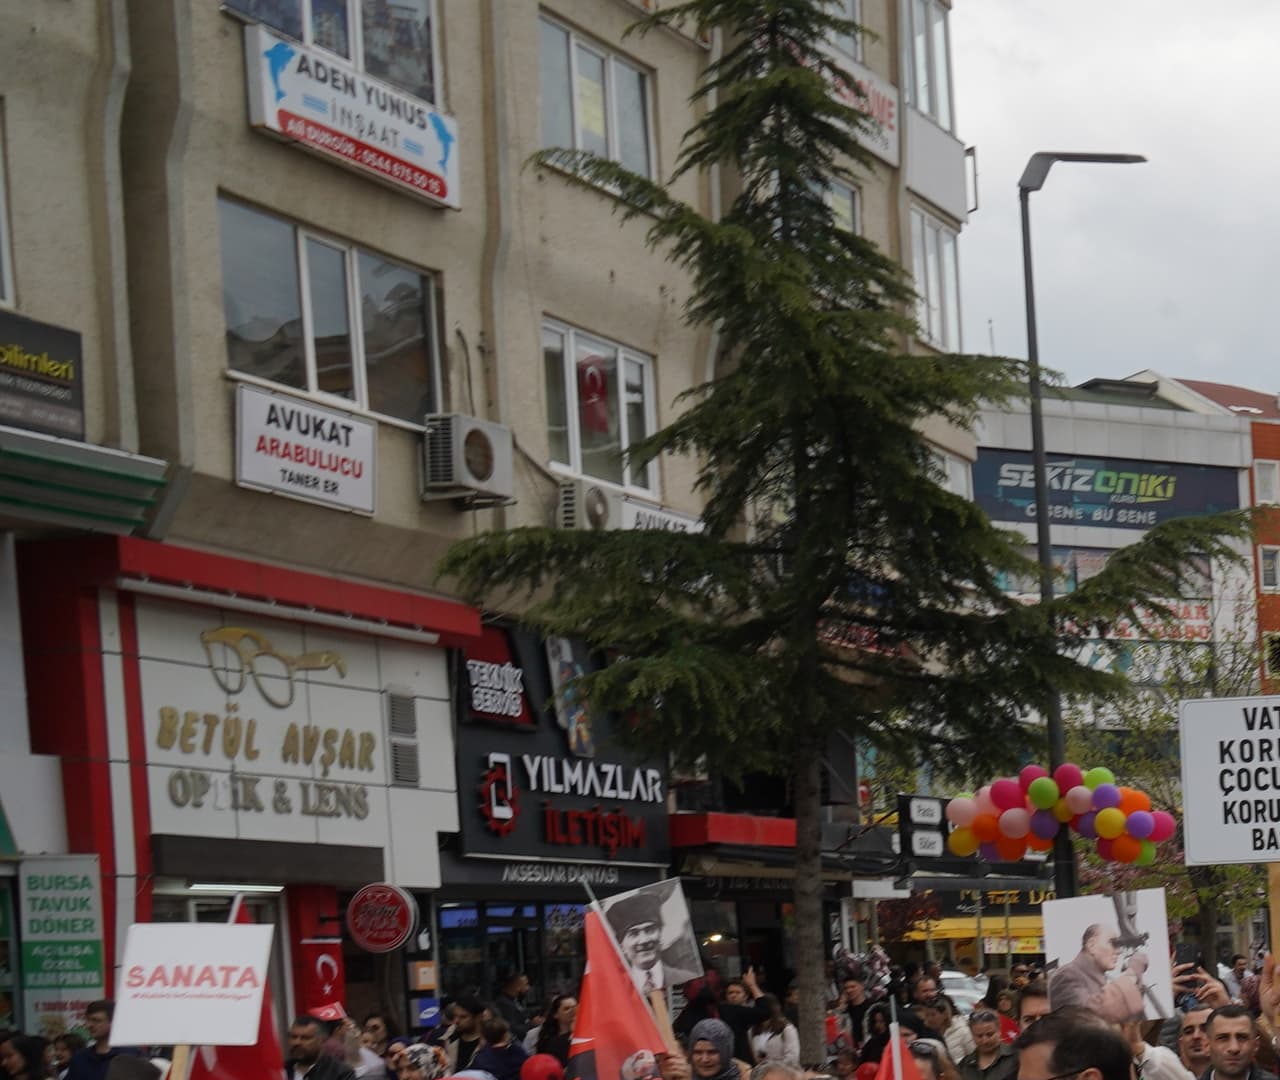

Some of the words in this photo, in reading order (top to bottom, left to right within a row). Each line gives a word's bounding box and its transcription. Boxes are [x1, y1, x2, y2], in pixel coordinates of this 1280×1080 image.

[296, 54, 358, 98] ADEN
[360, 81, 428, 131] YUNUS
[265, 403, 354, 449] AVUKAT
[255, 434, 364, 480] ARABULUCU
[279, 468, 321, 492] TANER
[322, 477, 340, 495] ER
[1092, 507, 1113, 522] BU
[1116, 508, 1157, 525] SENE
[466, 659, 524, 693] TEKNİK
[472, 686, 522, 718] SERVİS
[157, 702, 260, 761] BETÜL
[281, 721, 377, 777] AVŞAR
[521, 753, 665, 803] YILMAZLAR
[273, 780, 293, 815] &
[300, 778, 370, 821] LENS
[543, 800, 647, 860] İLETİŞİM
[26, 874, 93, 894] BURSA
[501, 864, 567, 886] AKSESUAR
[28, 895, 93, 914] TAVUK
[28, 915, 97, 936] DÖNER
[125, 964, 261, 989] SANATA
